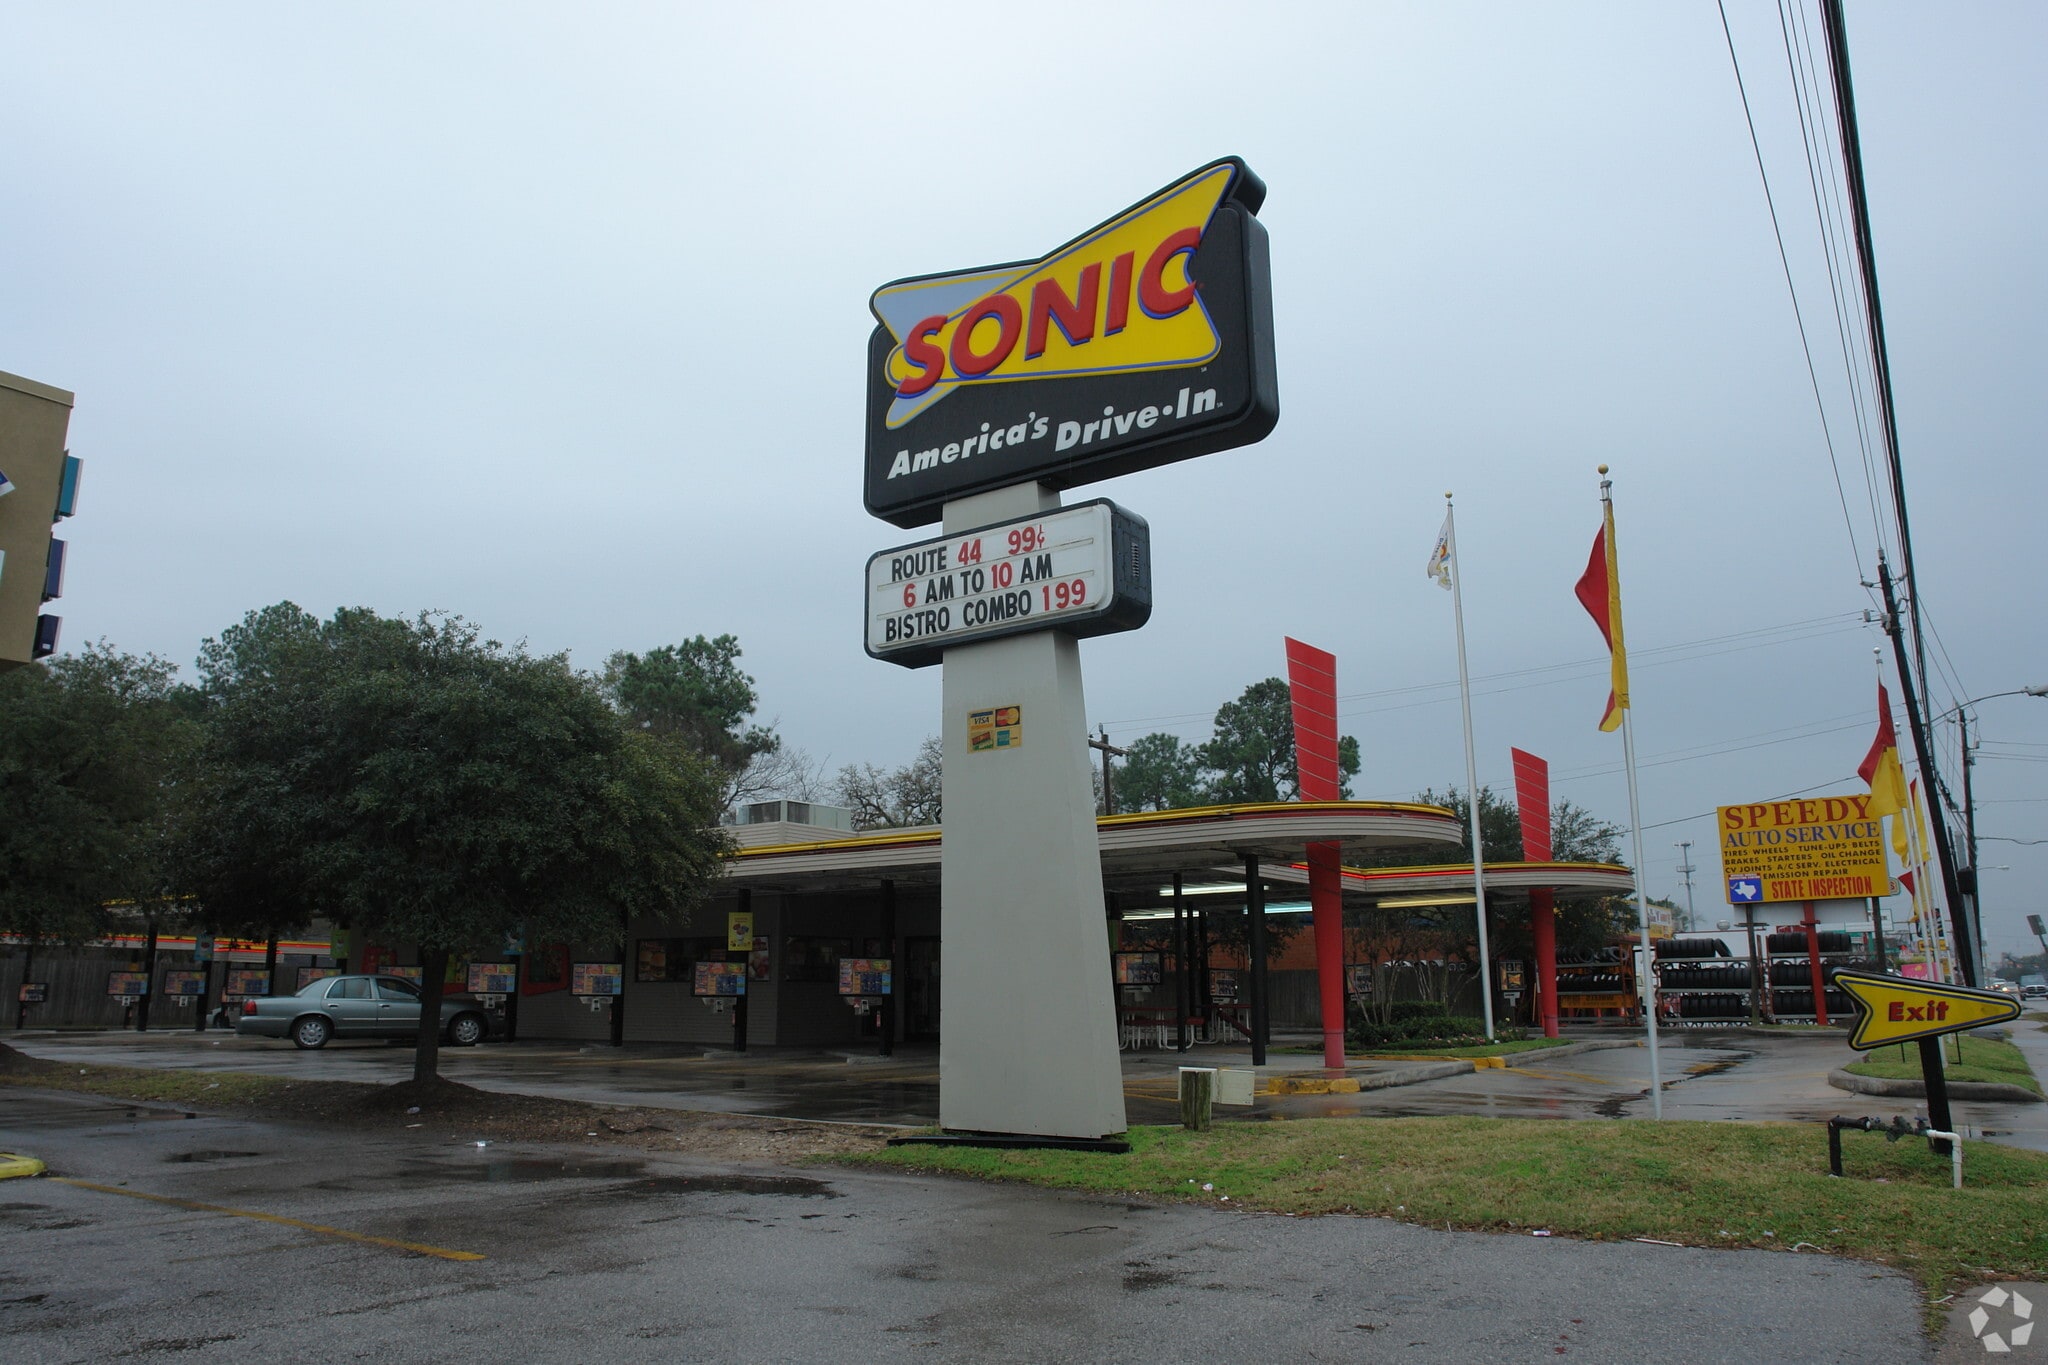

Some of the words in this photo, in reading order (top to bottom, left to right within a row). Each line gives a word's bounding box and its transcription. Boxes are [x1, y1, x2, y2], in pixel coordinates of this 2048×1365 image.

[895, 225, 1201, 399] SONIC
[887, 411, 1049, 480] America's
[891, 546, 947, 582] ROUTE
[957, 538, 982, 566] 44
[903, 583, 916, 608] 6
[925, 574, 954, 604] AM
[960, 568, 984, 595] TO
[991, 562, 1013, 589] 10
[1020, 553, 1052, 583] AM
[885, 607, 950, 642] BISTRO
[963, 589, 1032, 627] COMBO
[974, 717, 989, 725] VISA
[1725, 796, 1872, 830] SPEEDY
[1725, 829, 1782, 848] AUTO
[1785, 821, 1880, 844] SERVICE
[1724, 849, 1748, 857] TIRES
[1752, 846, 1789, 855] WHEELS
[1798, 843, 1847, 852] TUNE-UPS
[1852, 840, 1880, 848] BELTS
[1725, 857, 1759, 865] BRAKES
[1767, 854, 1812, 863] STARTERS
[1821, 851, 1837, 859] OIL
[1839, 849, 1881, 857] CHANGE
[1725, 866, 1737, 874] CV
[1739, 864, 1772, 872] JOINTS
[1777, 862, 1794, 870] A/C
[1825, 857, 1881, 867] ELECTRICAL
[1763, 871, 1809, 880] EMISSION
[1813, 868, 1849, 877] REPAIR
[1771, 878, 1804, 899] STATE
[1809, 876, 1873, 898] INSPECTION
[1887, 1000, 1950, 1022] Exit
